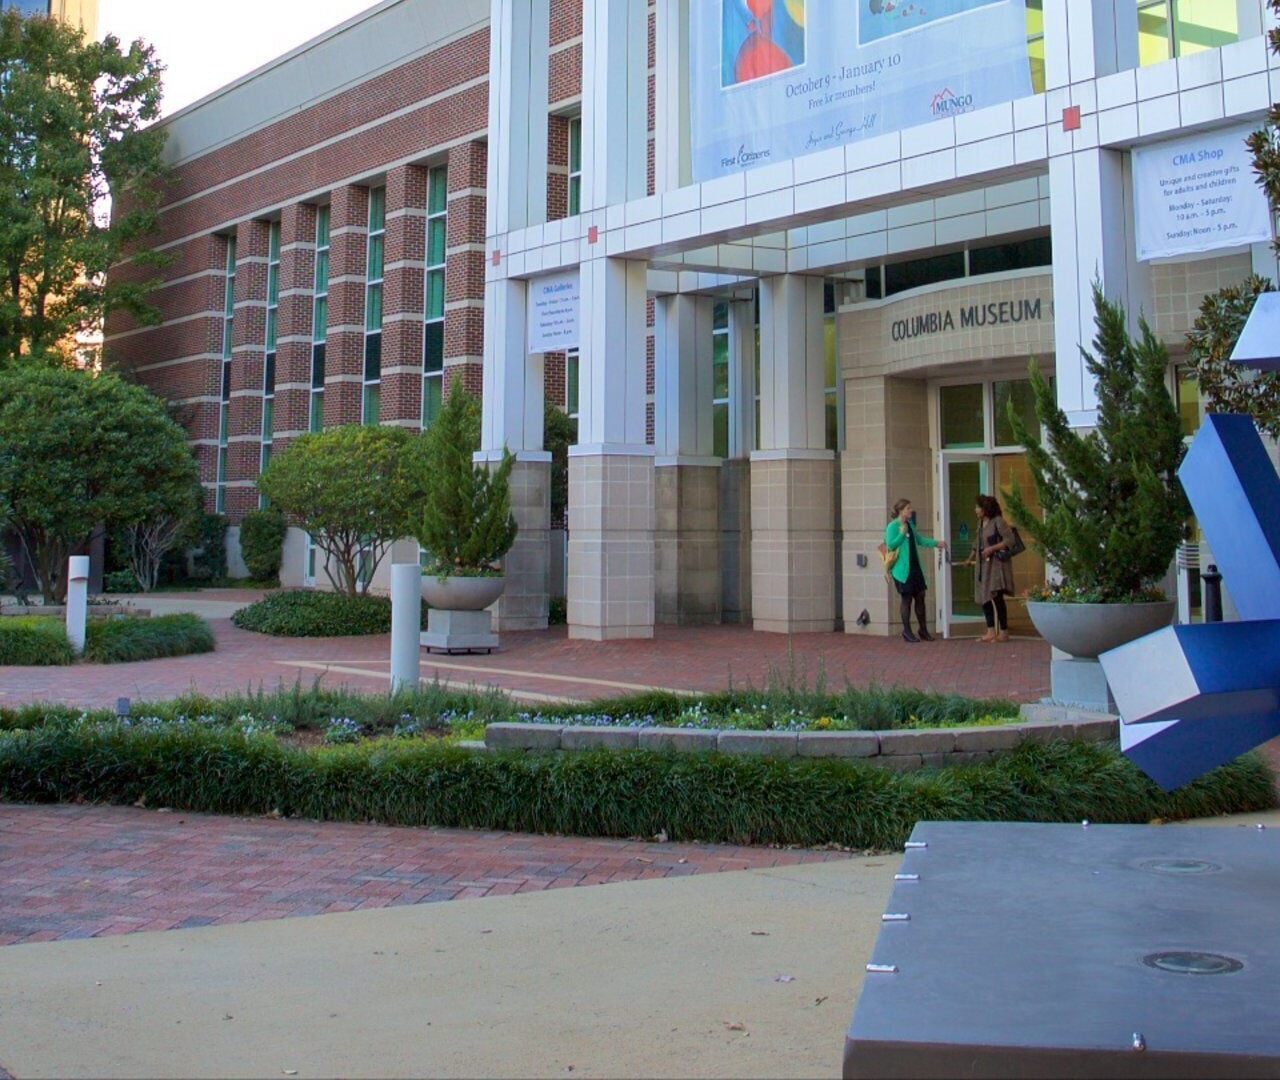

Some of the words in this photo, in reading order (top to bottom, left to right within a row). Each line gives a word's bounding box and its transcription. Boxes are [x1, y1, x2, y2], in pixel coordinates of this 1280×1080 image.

[786, 77, 823, 98] October
[839, 58, 885, 81] January
[888, 53, 901, 67] 10
[808, 98, 824, 110] Free
[936, 94, 973, 112] MUNGO
[721, 157, 736, 167] First
[1173, 152, 1196, 166] CMA
[1198, 148, 1223, 161] Shop
[1160, 177, 1182, 187] Unique
[1184, 173, 1196, 182] and
[1197, 168, 1223, 180] creative
[1224, 166, 1239, 176] gifts
[1174, 185, 1194, 195] adults
[1196, 182, 1208, 190] and
[1209, 177, 1236, 188] children
[1169, 201, 1194, 212] Monday
[1193, 226, 1211, 235] Noon
[892, 309, 955, 341] COLUMBIA
[960, 298, 1041, 328] MUSEUM
